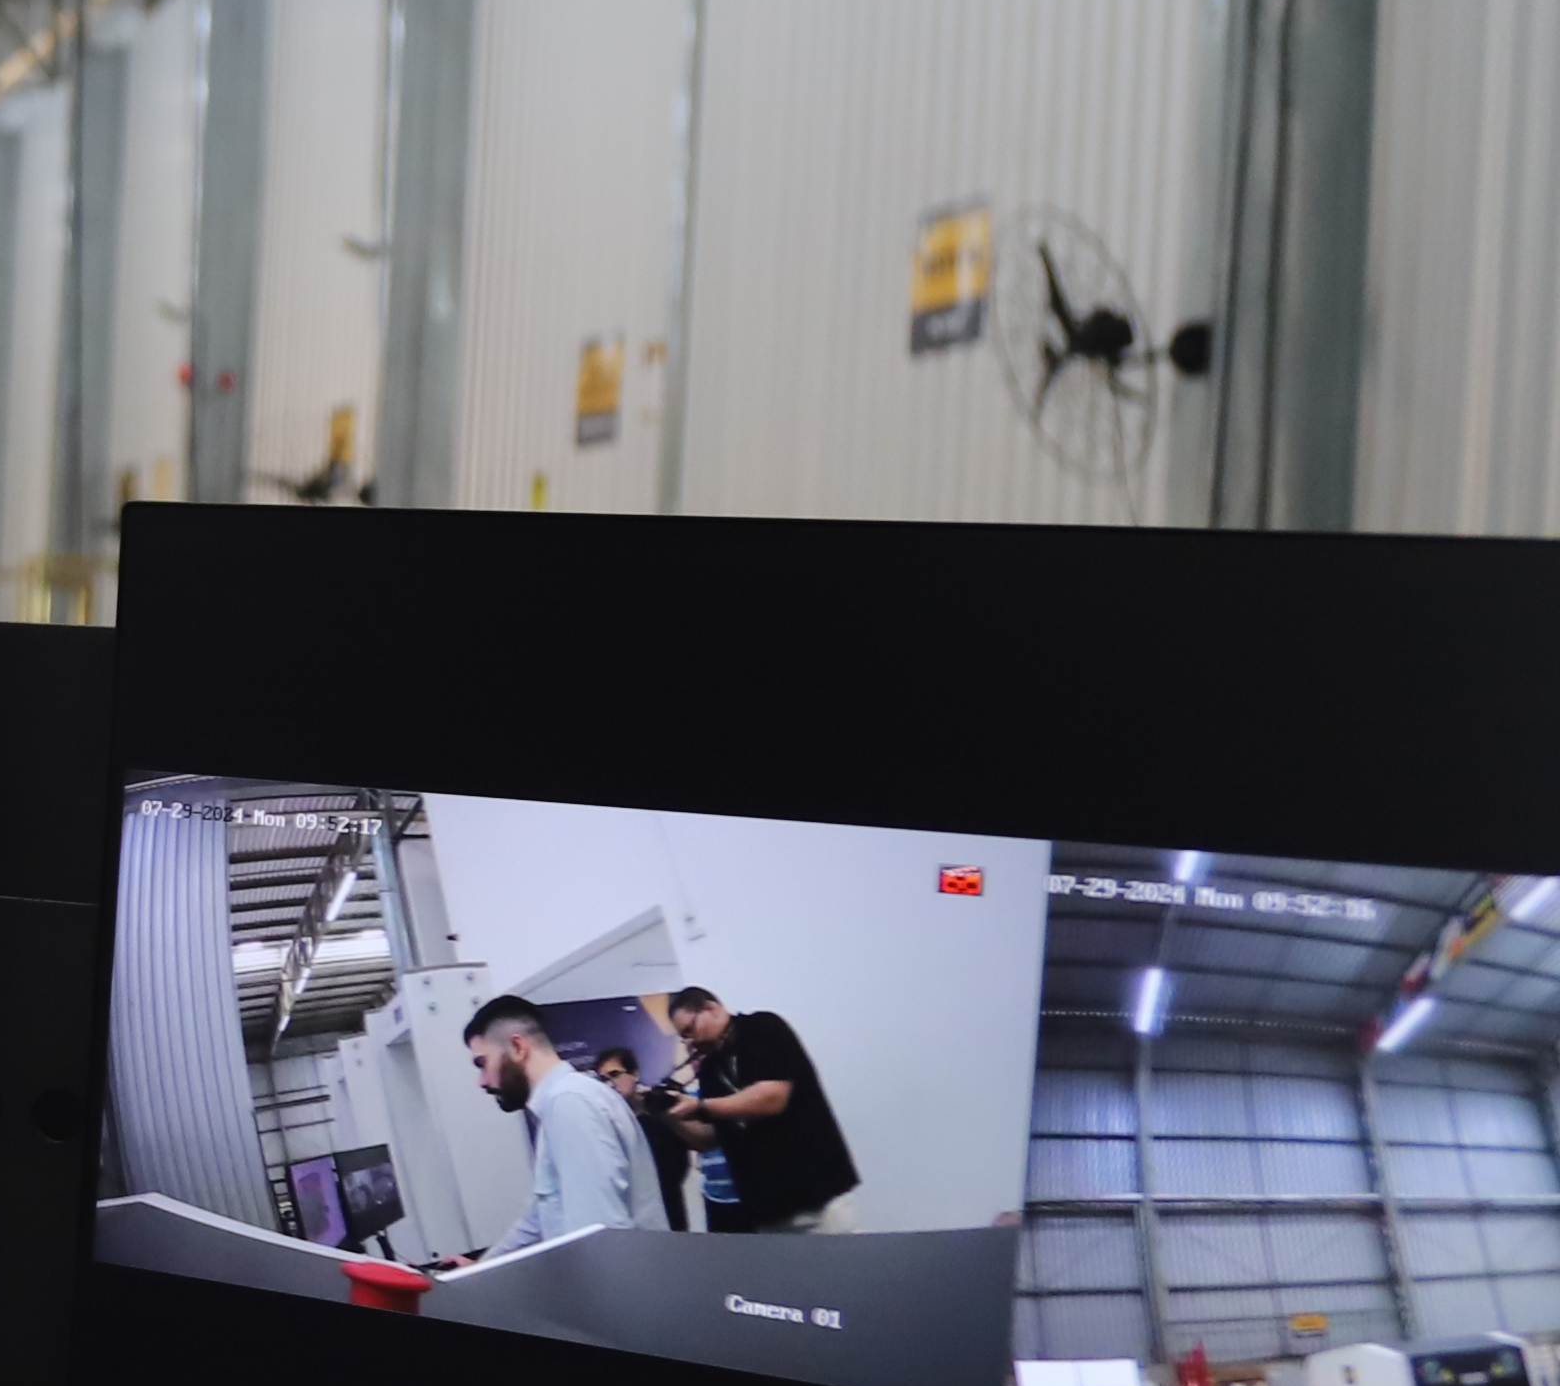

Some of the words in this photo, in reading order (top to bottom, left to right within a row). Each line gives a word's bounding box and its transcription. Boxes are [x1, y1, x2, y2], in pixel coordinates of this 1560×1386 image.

[253, 810, 286, 828] Mon
[295, 814, 383, 836] 09:52:17
[1044, 874, 1187, 906] 07-29-2024
[1194, 886, 1245, 910] Mon
[725, 1294, 805, 1323] Camera
[811, 1307, 843, 1329] 01
